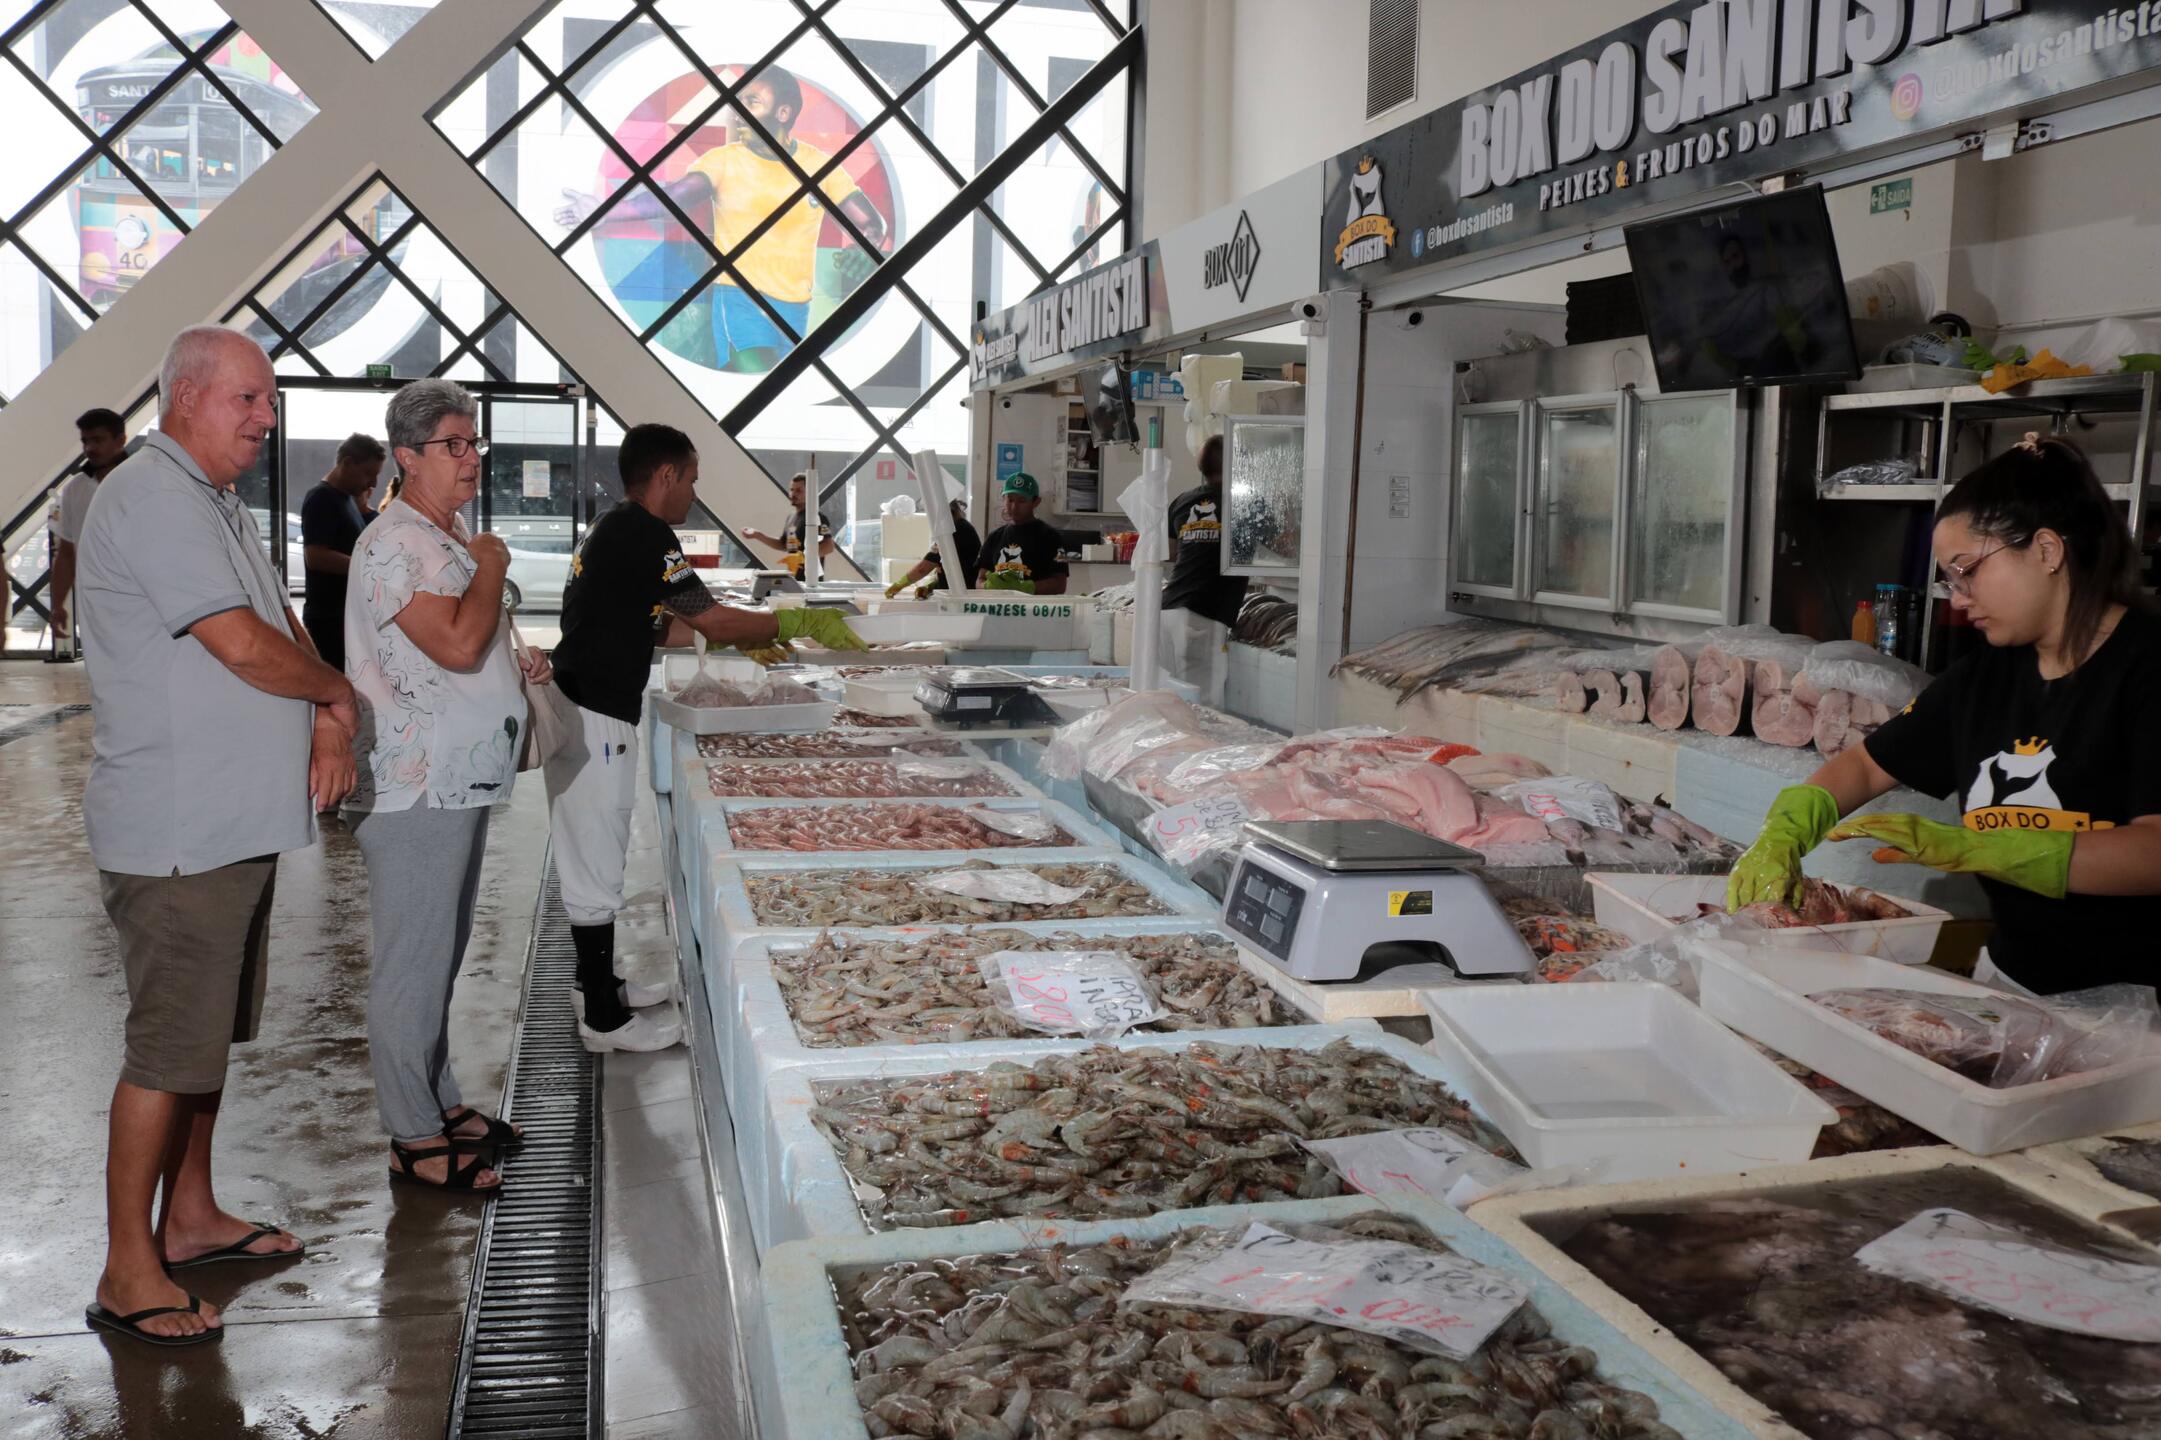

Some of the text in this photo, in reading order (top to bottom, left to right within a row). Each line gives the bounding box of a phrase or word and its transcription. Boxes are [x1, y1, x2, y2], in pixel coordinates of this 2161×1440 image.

[1460, 0, 2022, 198] BOX DO SANTIS
[1540, 90, 1850, 211] PEIXES & FRUTOS DO MAR
[1350, 219, 1378, 239] BOX DO
[1427, 202, 1514, 250] @boxdosantista
[1204, 233, 1250, 290] BOX 01
[1342, 235, 1387, 271] SANTISTA
[1027, 256, 1147, 362] ALEX SANTISTA
[964, 603, 1071, 617] FRANZESE 08/15
[1975, 812, 2050, 831] BOX DO
